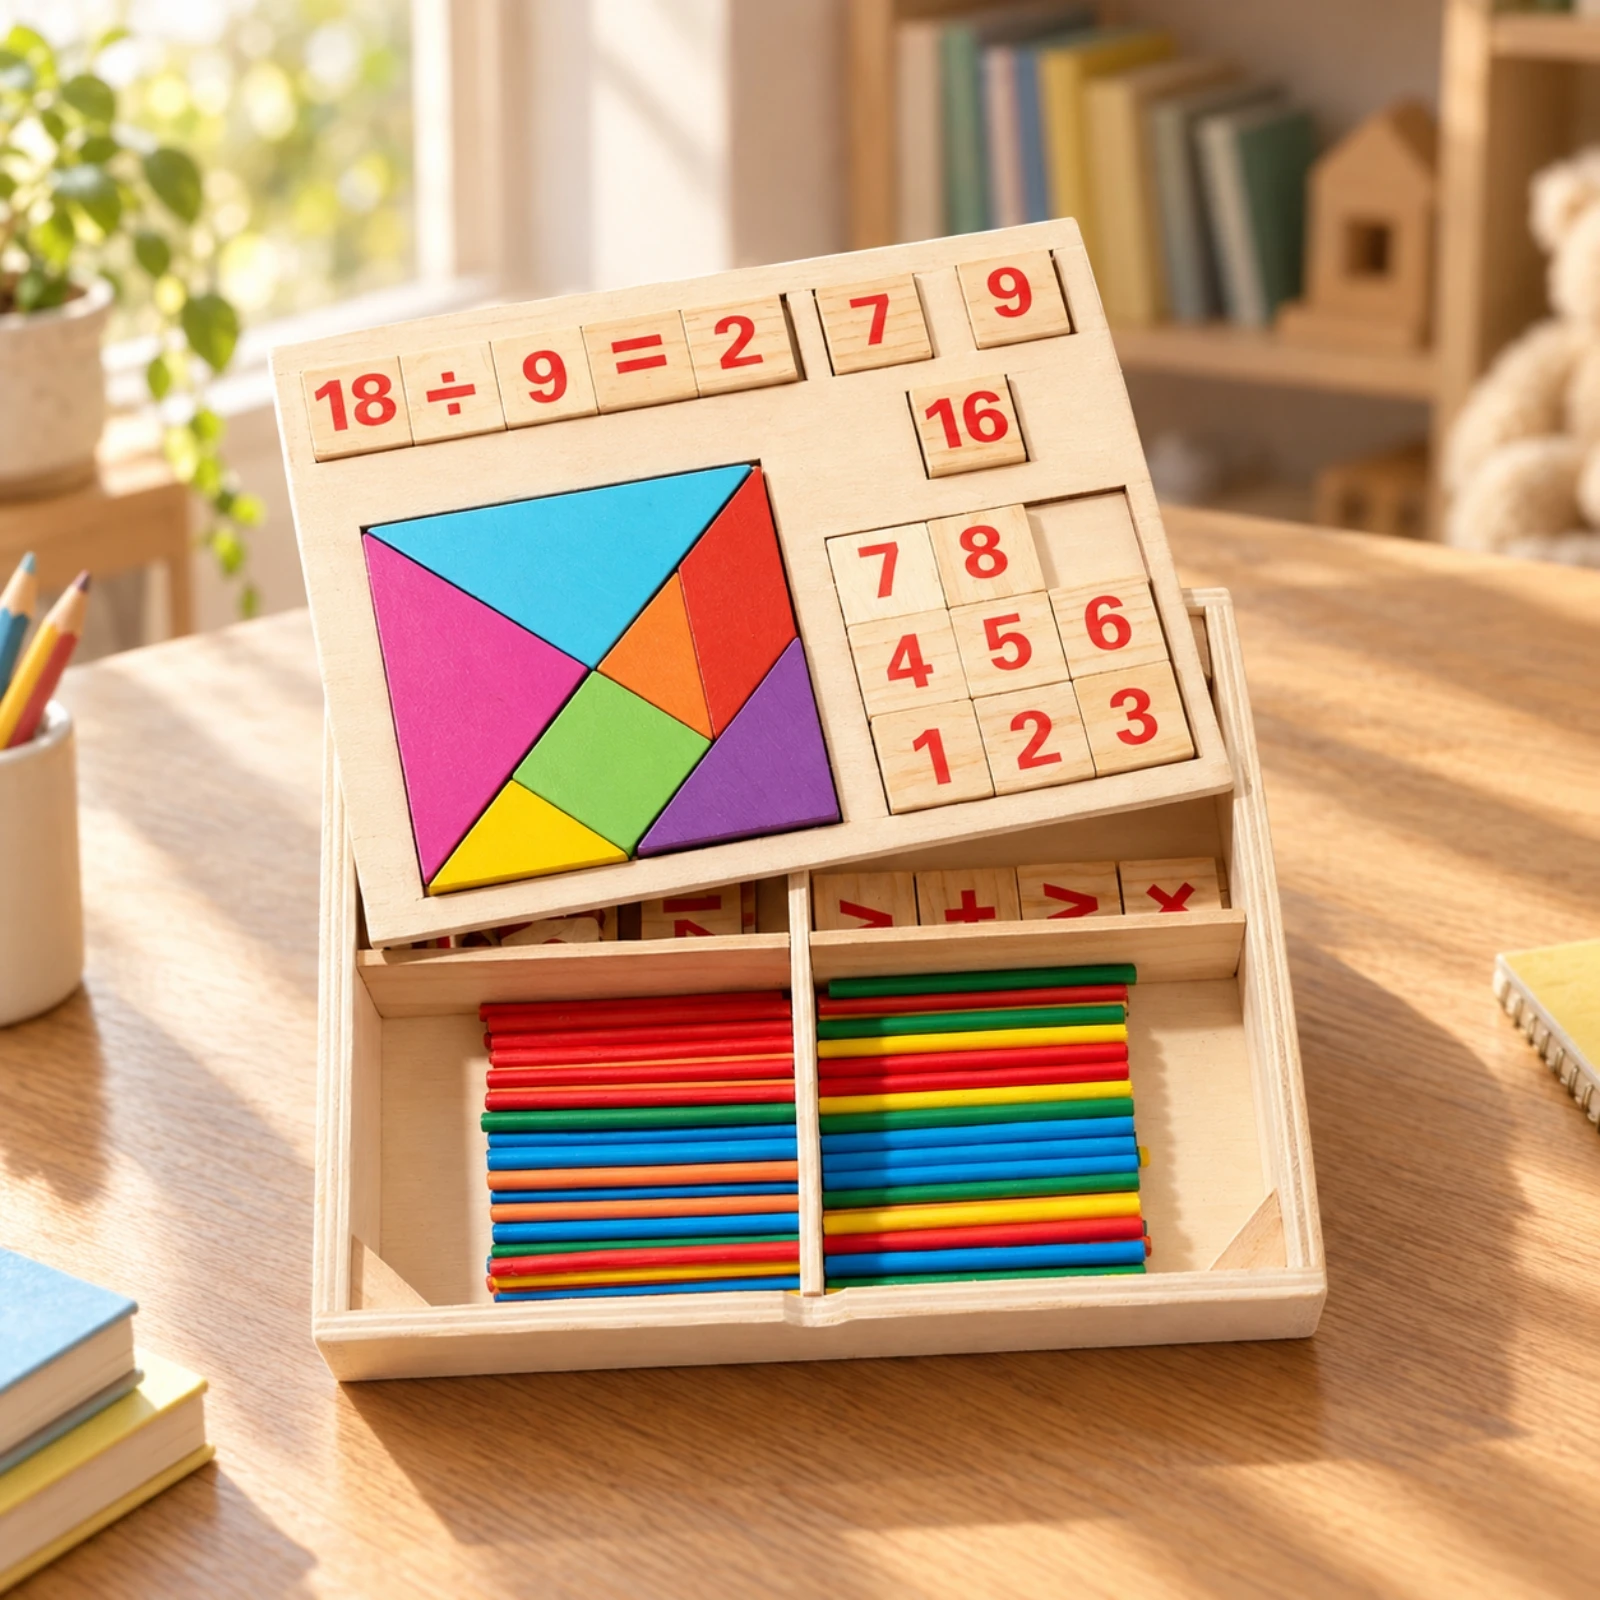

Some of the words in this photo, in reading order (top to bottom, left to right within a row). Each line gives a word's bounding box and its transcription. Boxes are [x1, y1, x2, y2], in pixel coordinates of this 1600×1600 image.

[850, 294, 889, 345] 7
[988, 267, 1032, 317] 9
[315, 374, 396, 430] 18
[523, 351, 566, 403] 9
[612, 335, 667, 374] =
[715, 316, 763, 369] 2
[926, 391, 1008, 448] 16
[859, 542, 898, 597] 7
[960, 526, 1007, 578] 8
[888, 634, 933, 688] 4
[984, 614, 1031, 670] 5
[1085, 596, 1131, 650] 6
[913, 729, 950, 784] 1
[1010, 711, 1061, 769] 2
[1110, 688, 1157, 745] 3
